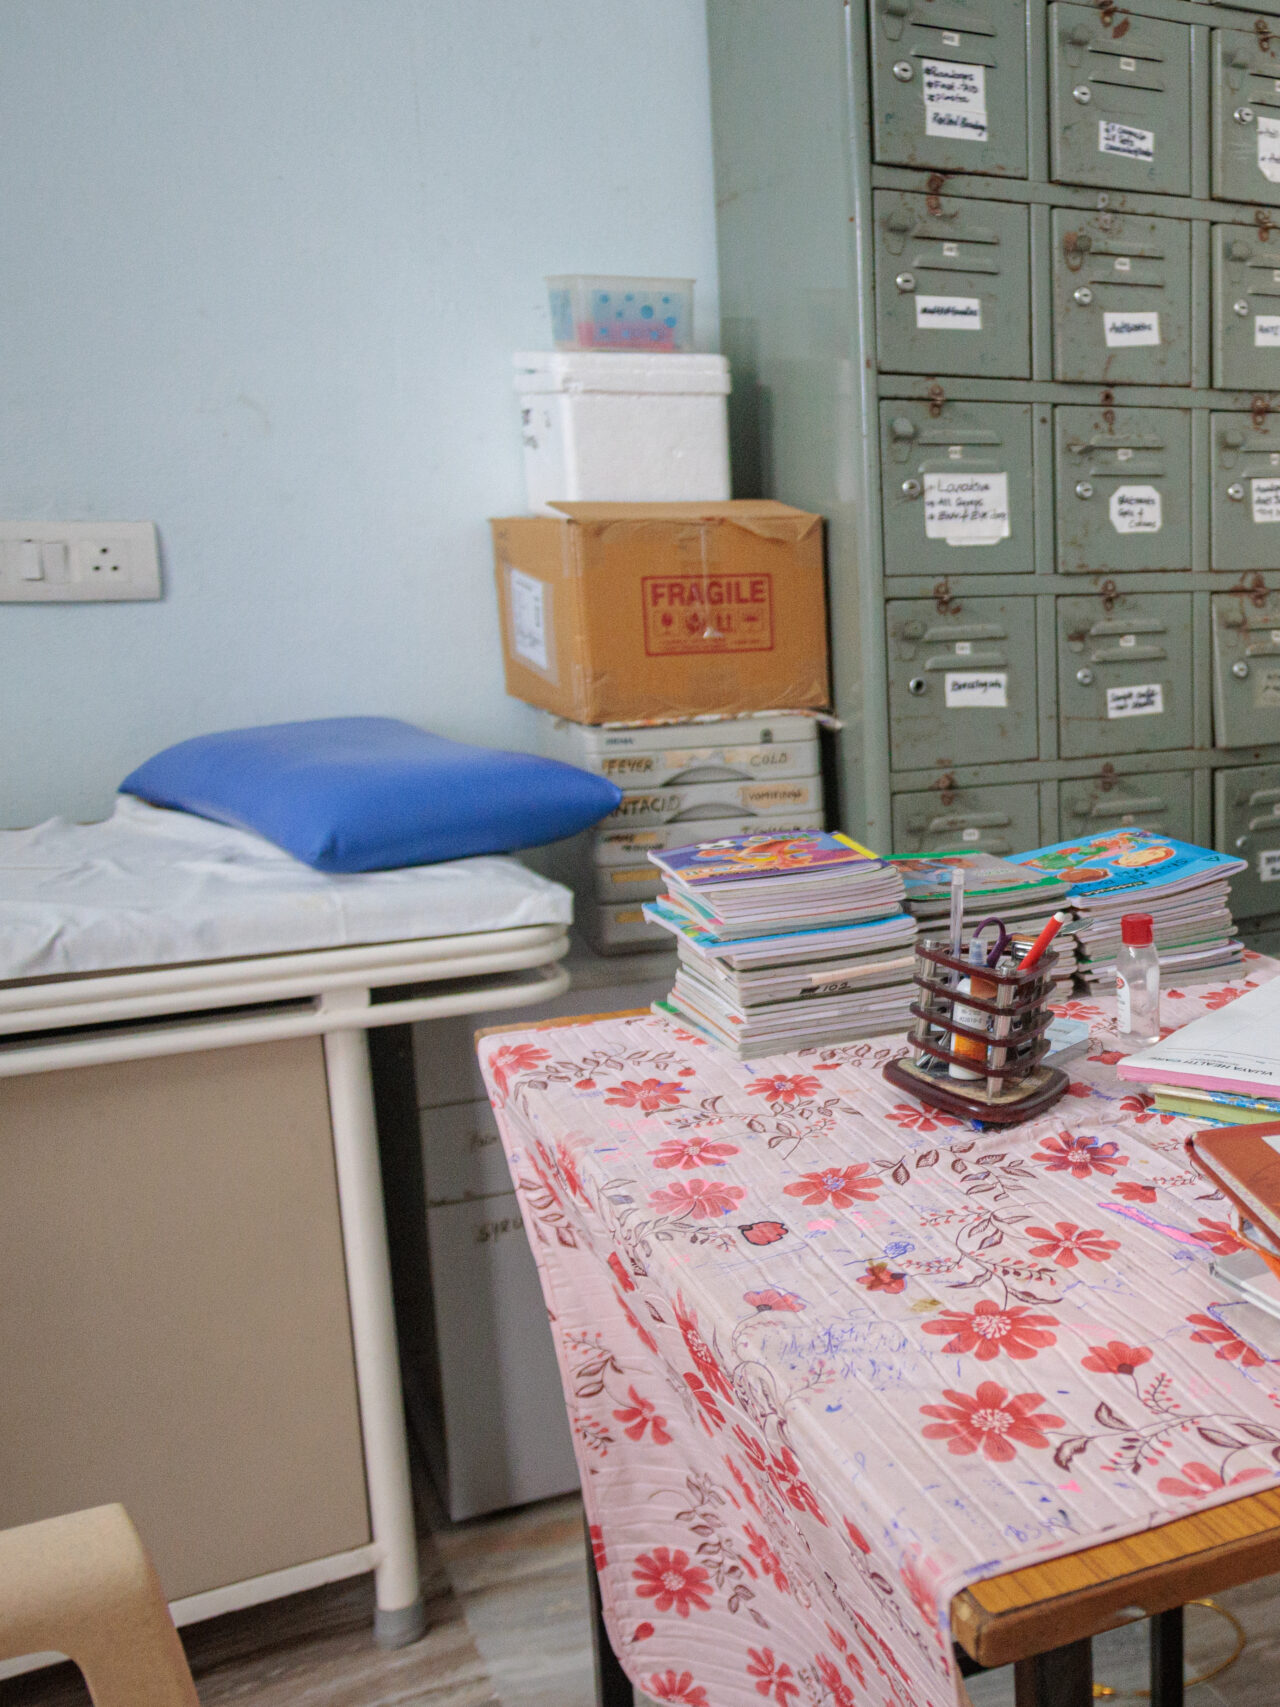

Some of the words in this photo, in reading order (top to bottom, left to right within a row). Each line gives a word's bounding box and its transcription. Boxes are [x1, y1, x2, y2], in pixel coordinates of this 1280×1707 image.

[651, 580, 767, 607] FRAGILE
[607, 758, 654, 776] FEVER
[611, 793, 681, 818] NTACID
[1183, 1059, 1231, 1069] HEALTH
[1233, 1066, 1273, 1077] VIJAYA
